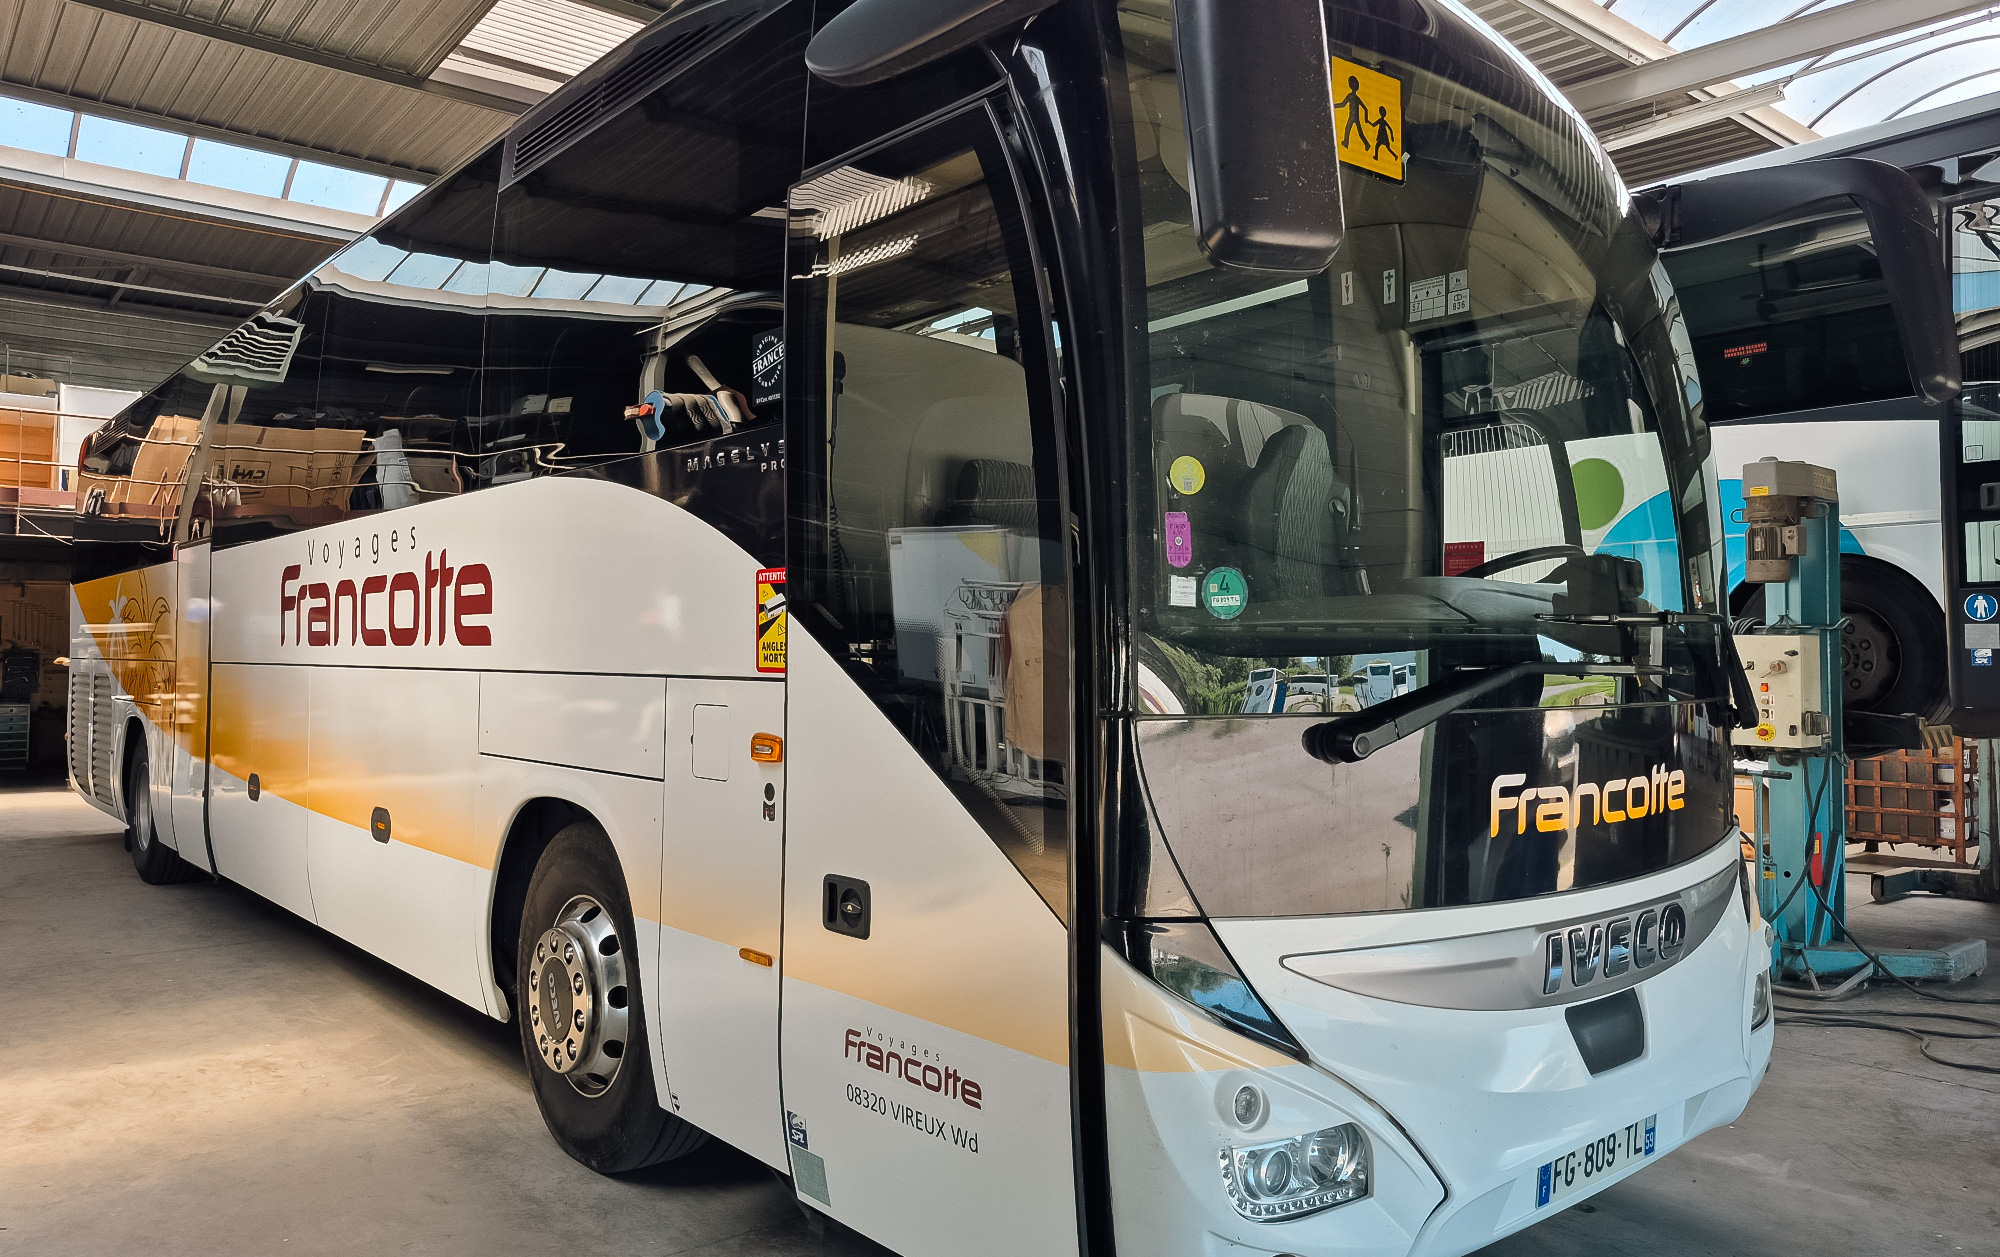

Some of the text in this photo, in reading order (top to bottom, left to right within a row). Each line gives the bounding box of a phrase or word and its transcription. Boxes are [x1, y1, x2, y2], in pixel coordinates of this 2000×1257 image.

[752, 343, 785, 375] FRANCE
[307, 526, 416, 569] Voyages
[280, 548, 493, 647] Francotte
[1219, 574, 1231, 594] 4
[1490, 762, 1685, 838] Francotte
[1543, 902, 1687, 996] IVECO
[547, 971, 563, 1031] IVECO
[844, 1028, 982, 1110] Francotte
[866, 1026, 940, 1062] Voyages
[846, 1083, 979, 1154] 08320 VIREUX Wd
[1542, 1122, 1654, 1198] F FG-809-TL 59
